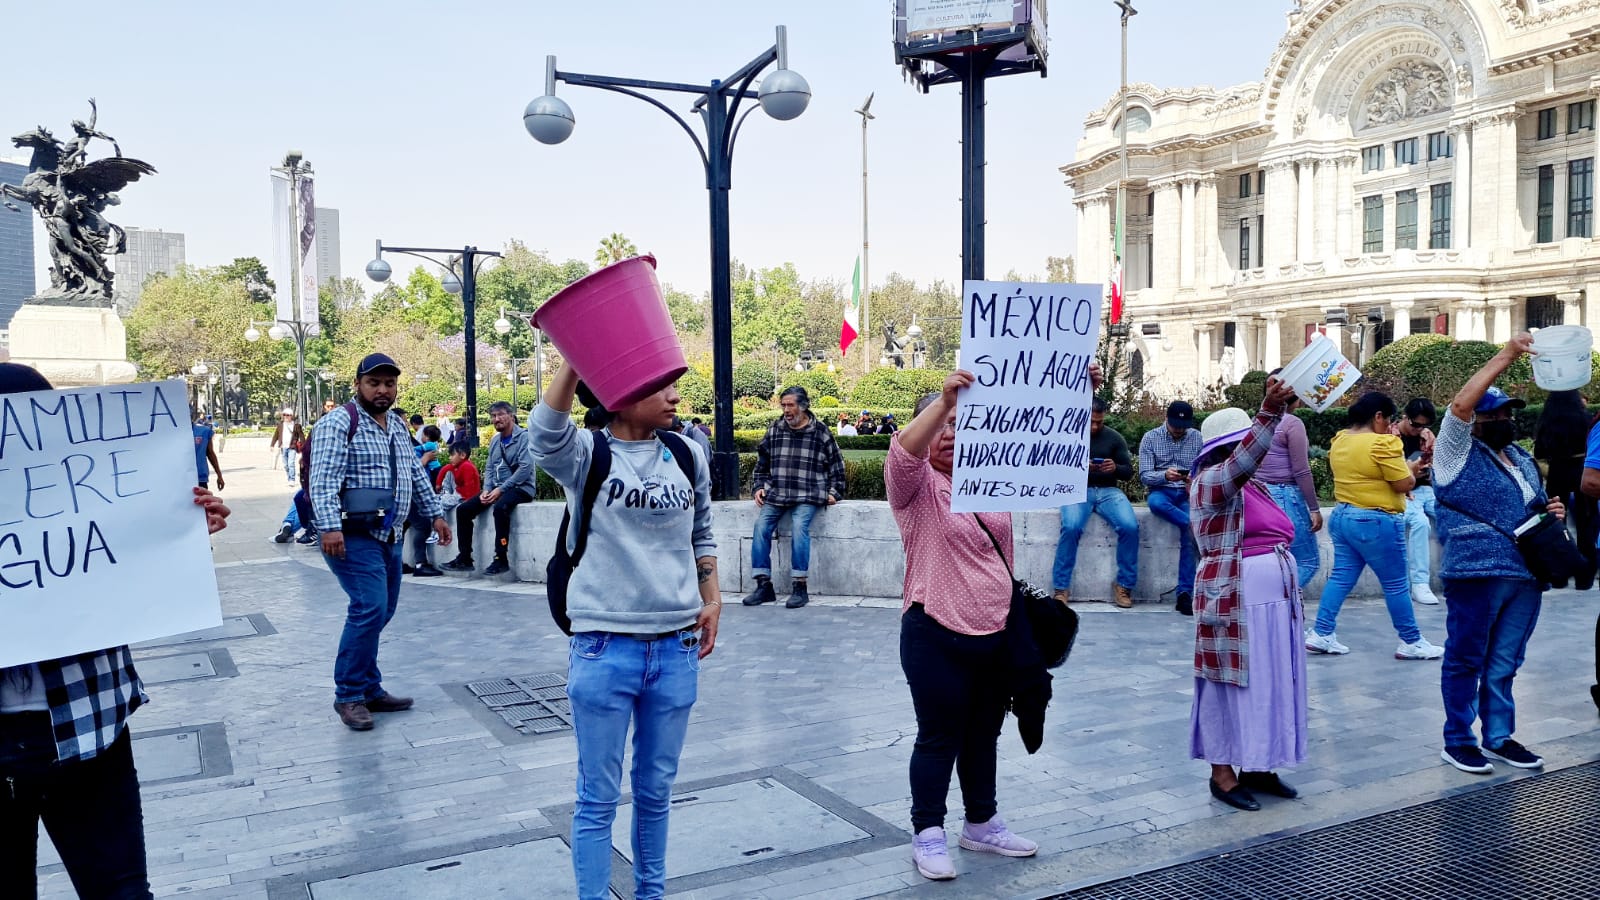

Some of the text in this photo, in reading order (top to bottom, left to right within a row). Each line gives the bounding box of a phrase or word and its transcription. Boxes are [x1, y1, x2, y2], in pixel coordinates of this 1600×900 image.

[1368, 53, 1385, 69] DE
[1391, 43, 1440, 58] BELLAS
[970, 287, 1092, 341] MÉXICO
[974, 350, 1091, 395] SIN AGUA
[1057, 406, 1091, 440] PLAN
[957, 441, 1026, 469] HIDRICO
[0, 450, 150, 526] ERE
[958, 478, 1017, 497] ANTES
[1020, 484, 1037, 497] DE
[1039, 487, 1050, 497] LO
